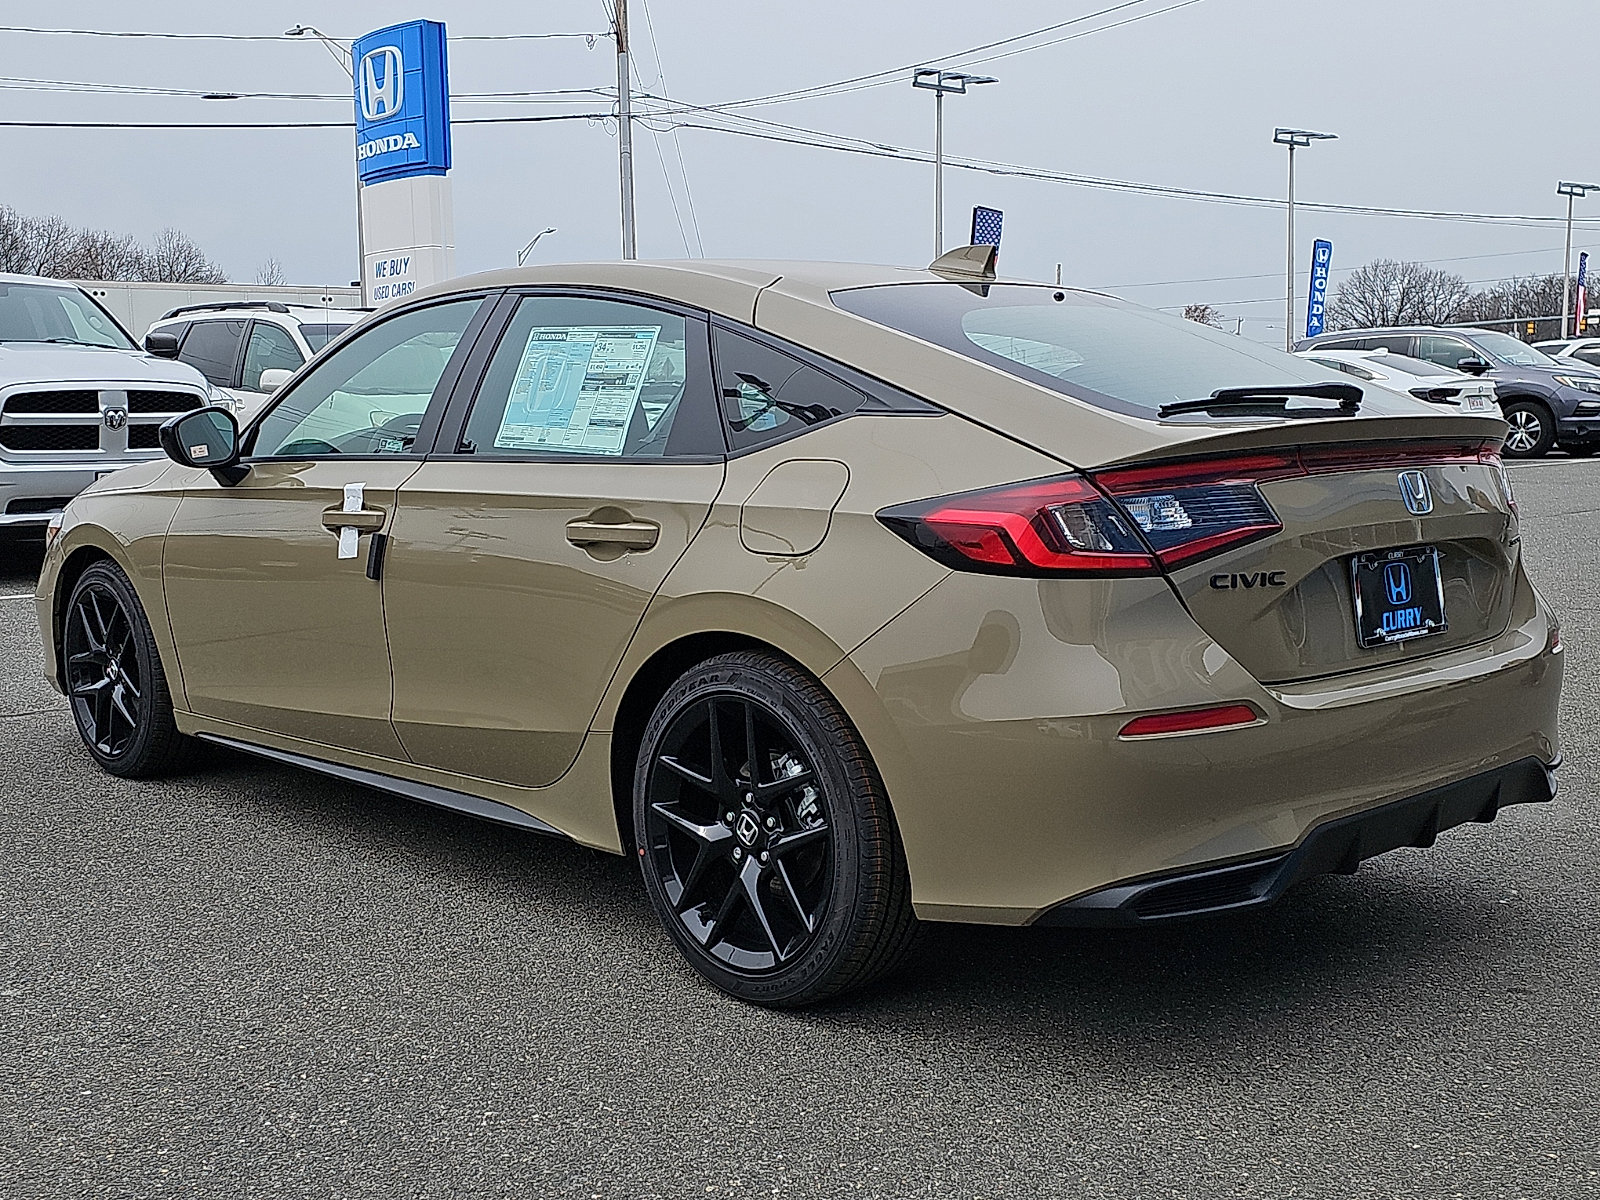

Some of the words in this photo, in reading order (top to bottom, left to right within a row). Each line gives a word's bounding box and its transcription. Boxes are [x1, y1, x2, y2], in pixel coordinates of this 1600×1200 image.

[357, 132, 420, 160] HONDA
[375, 260, 387, 278] WE
[389, 256, 410, 276] BUY
[374, 285, 390, 300] USED
[1309, 266, 1327, 327] HONDA
[1210, 571, 1287, 589] CIVIC
[1383, 606, 1423, 632] CURRY
